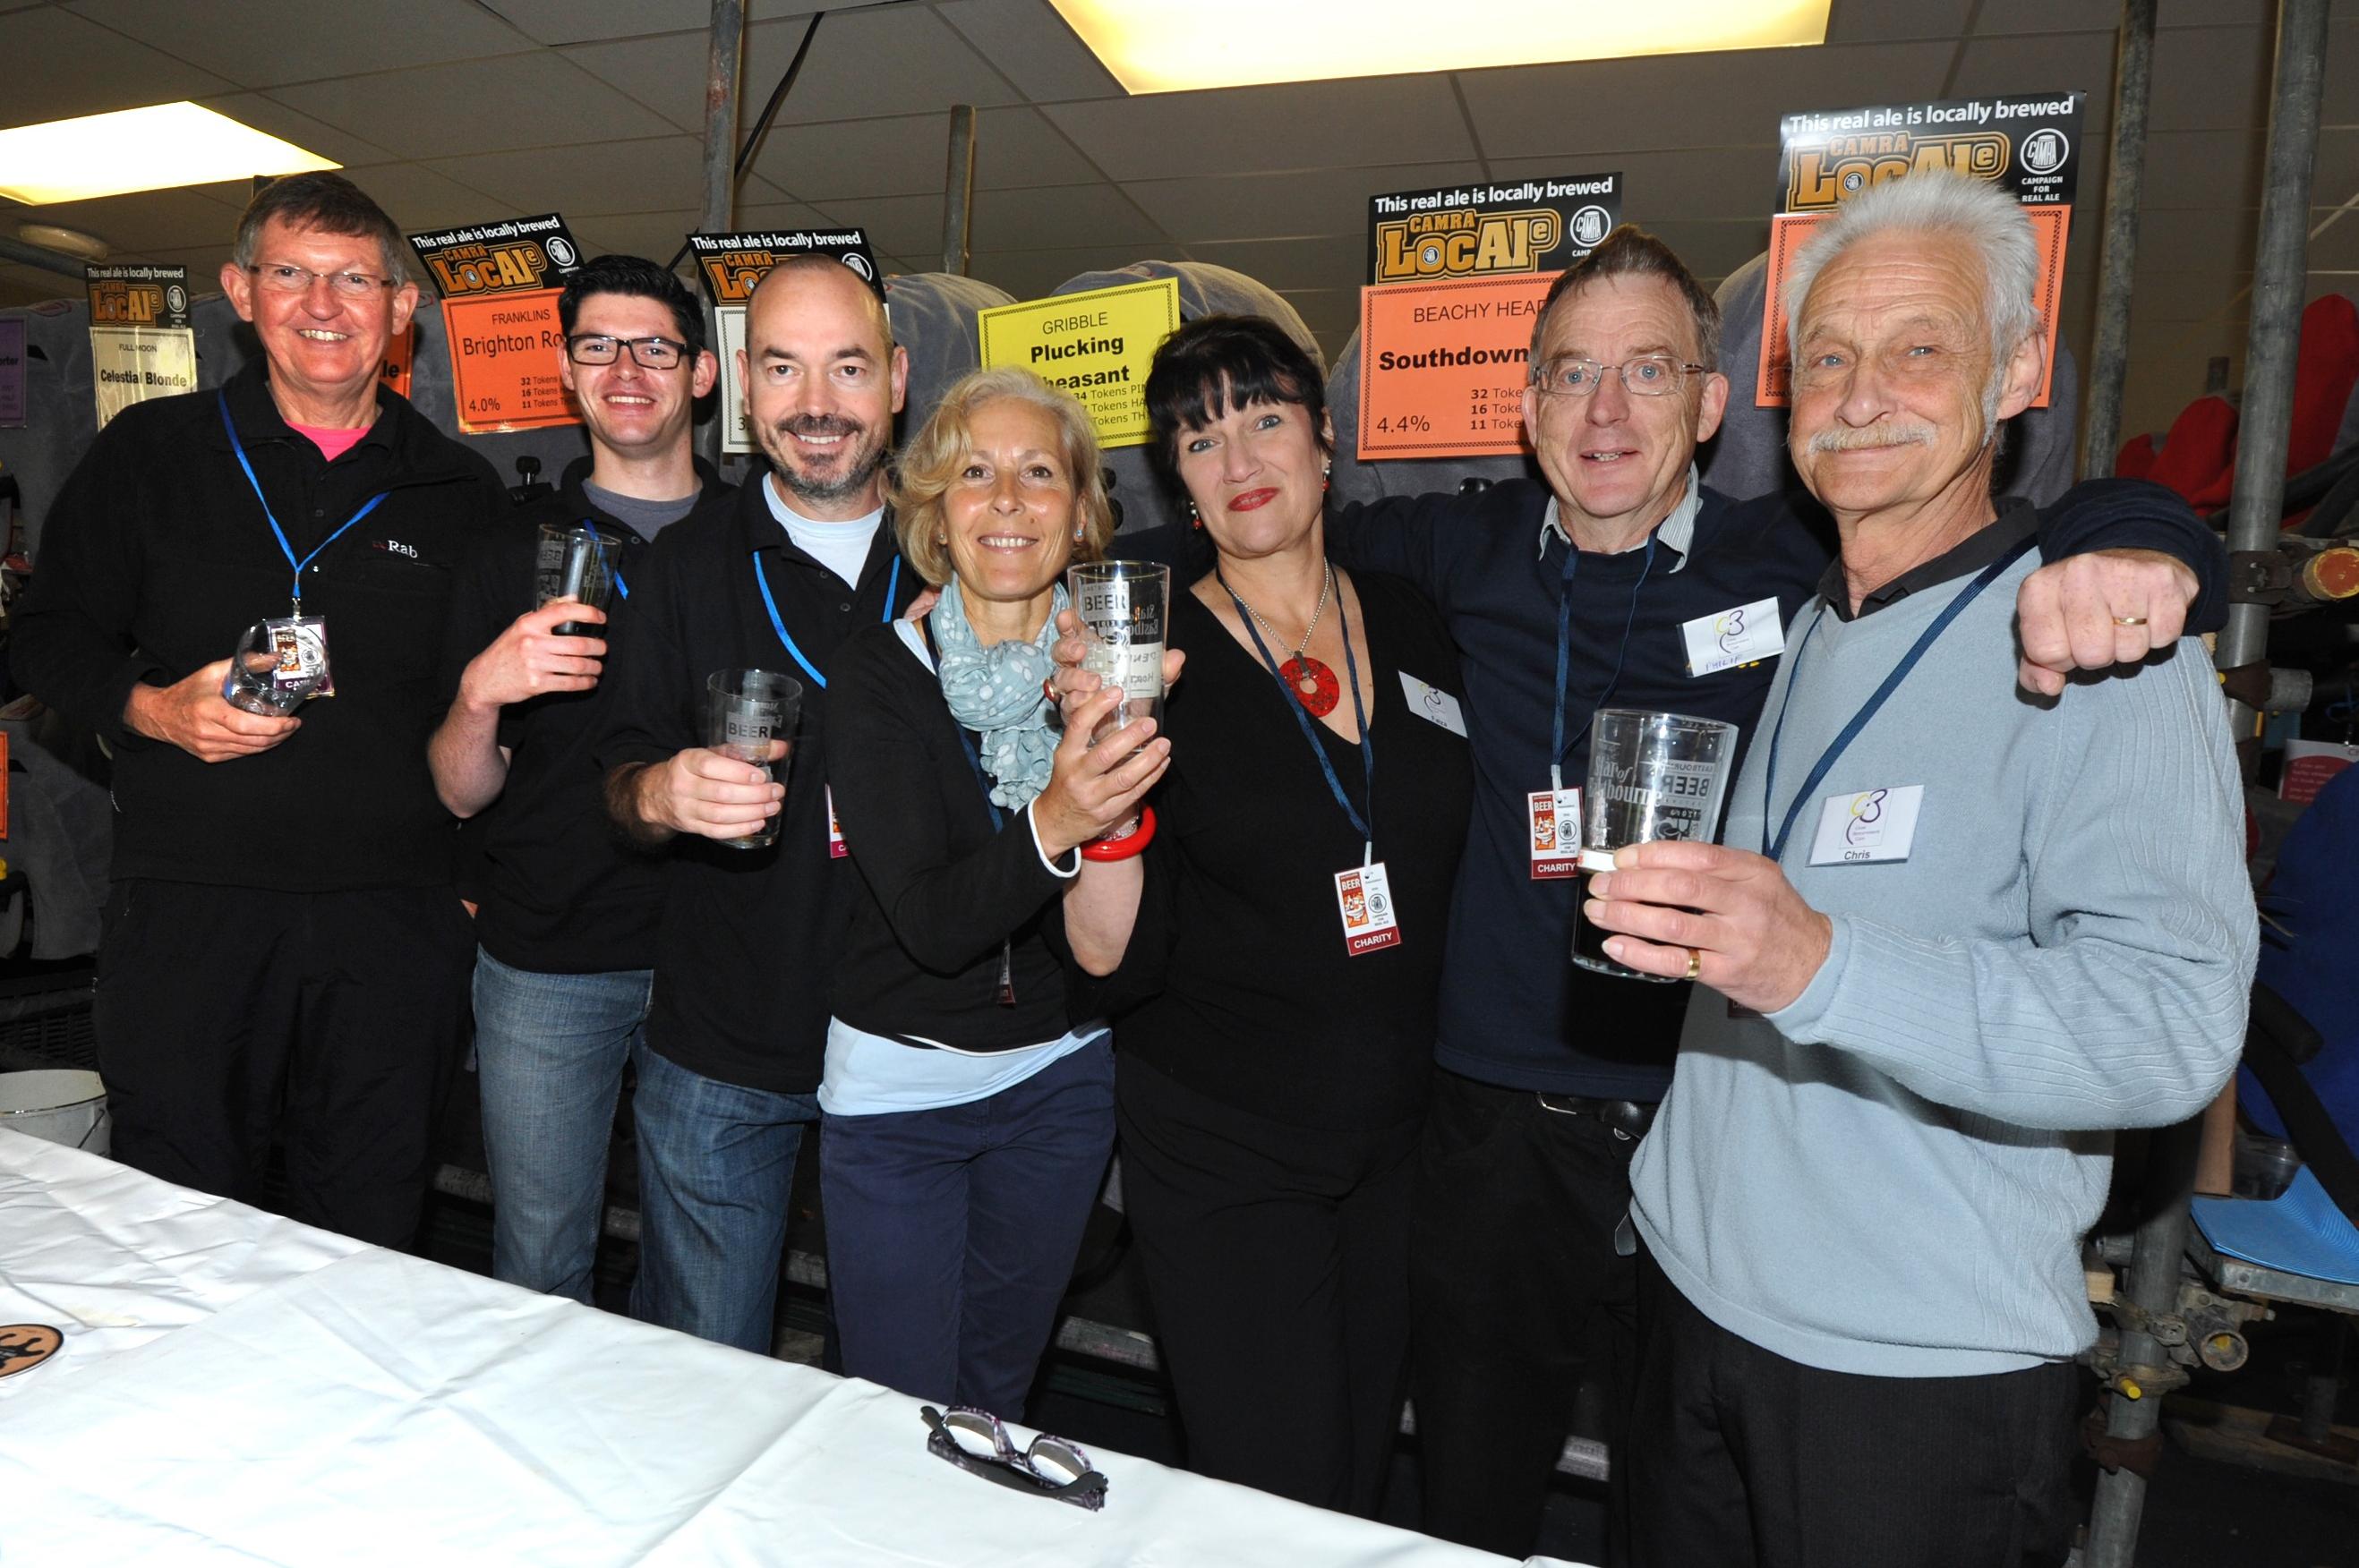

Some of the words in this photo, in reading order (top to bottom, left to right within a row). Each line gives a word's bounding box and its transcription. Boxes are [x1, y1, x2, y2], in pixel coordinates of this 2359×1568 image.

[1790, 115, 1829, 133] This
[1833, 110, 1869, 131] real
[1873, 107, 1903, 127] ale
[1906, 107, 1922, 125] is
[1926, 101, 1992, 124] locally
[1995, 95, 2074, 119] brewed
[1829, 132, 1909, 157] CAMRA
[2021, 175, 2064, 185] CAMPAIGN
[1375, 197, 1408, 214] This
[1411, 192, 1441, 210] real
[1444, 190, 1469, 207] ale
[1473, 188, 1486, 204] is
[1489, 183, 1543, 203] locally
[1546, 176, 1612, 199] brewed
[2033, 185, 2050, 193] FOR
[2021, 194, 2043, 202] REAL
[2044, 193, 2060, 201] ALE
[1409, 211, 1475, 234] CAMRA
[412, 234, 437, 249] This
[437, 232, 457, 245] real
[457, 229, 474, 243] ale
[473, 227, 483, 240] is
[484, 223, 518, 238] locally
[518, 216, 560, 233] brewed
[692, 236, 717, 250] This
[718, 235, 742, 249] real
[743, 234, 762, 248] ale
[761, 234, 774, 247] is
[774, 232, 813, 249] locally
[815, 231, 862, 245] brewed
[443, 245, 489, 262] CAMRA
[724, 252, 774, 267] CAMRA
[1572, 249, 1593, 257] CAMP
[88, 268, 99, 278] This
[100, 268, 112, 278] real
[112, 268, 122, 278] ale
[123, 268, 128, 278] is
[129, 268, 153, 280] locally
[154, 268, 184, 279] brewed
[491, 310, 551, 325] FRANKLINS
[1414, 302, 1491, 323] BEACHY
[1042, 311, 1108, 335] GRIBBLE
[136, 345, 157, 353] MOON
[463, 335, 534, 358] Brighton
[542, 330, 563, 348] Ro
[1030, 337, 1124, 363] Plucking
[0, 356, 19, 365] orter
[382, 360, 399, 379] le
[1043, 365, 1130, 389] heasant
[100, 369, 143, 384] Celestial
[146, 371, 187, 388] Blonde
[520, 377, 531, 386] 32
[533, 376, 558, 385] Tokens
[522, 388, 531, 397] 16
[533, 388, 558, 396] Tokens
[1090, 388, 1127, 399] Tokens
[1131, 384, 1146, 394] PIN
[1471, 389, 1488, 399] 32
[1492, 388, 1523, 399] Toke
[468, 397, 501, 412] 4.0%
[522, 400, 532, 409] 11
[534, 399, 559, 408] Tokens
[1091, 401, 1128, 413] Tokens
[1131, 398, 1146, 408] HA
[1471, 404, 1487, 414] 16
[1492, 403, 1522, 414] Toke
[738, 417, 750, 430] 3.
[1093, 414, 1128, 426] Tokens
[1377, 414, 1431, 433] 4.4%
[1470, 420, 1486, 430] 11
[1491, 418, 1521, 430] Toke
[388, 540, 418, 558] Rab
[1084, 584, 1126, 592] EASTBOURE
[1084, 594, 1126, 611] BEER
[728, 721, 769, 738] BEER
[1534, 801, 1553, 812] BEER
[1844, 849, 1870, 860] Chris
[1537, 863, 1577, 873] CHARITY
[1341, 878, 1361, 891] BEER
[1354, 932, 1393, 949] CHARITY
